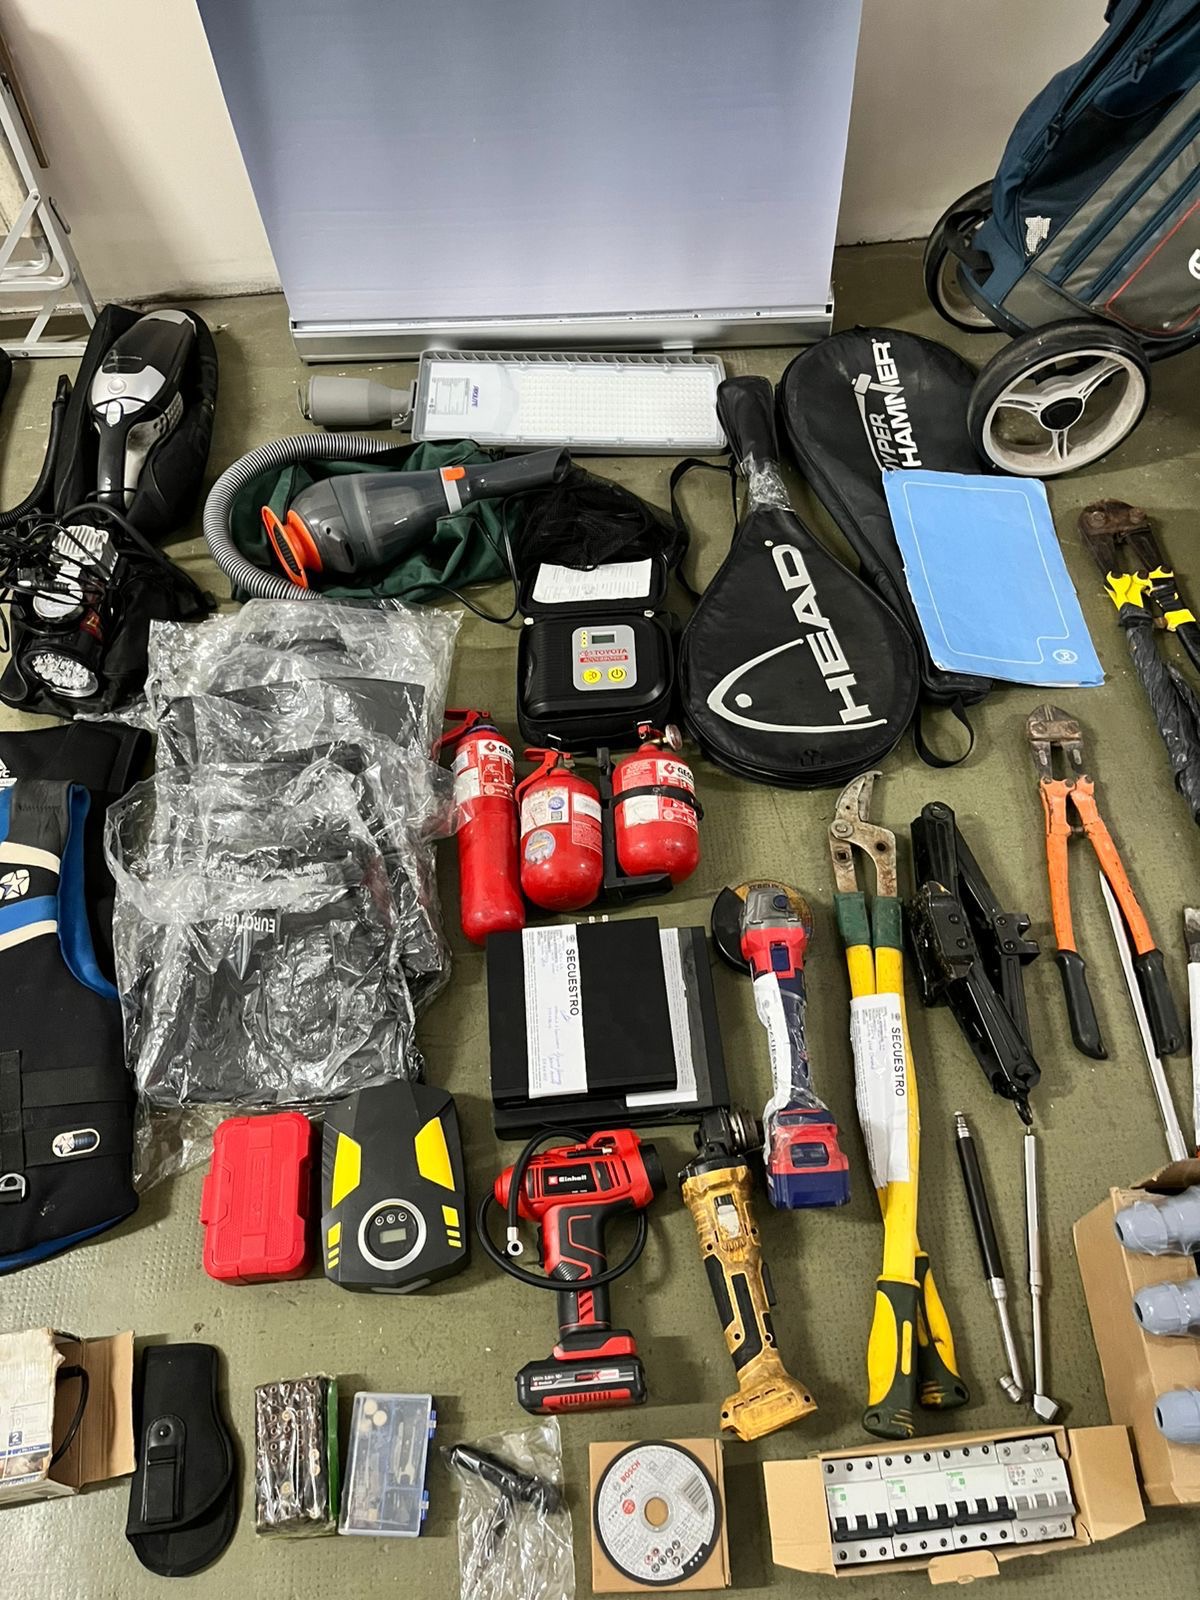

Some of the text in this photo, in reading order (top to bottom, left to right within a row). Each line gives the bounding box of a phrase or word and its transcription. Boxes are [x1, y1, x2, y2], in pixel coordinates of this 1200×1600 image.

[872, 341, 922, 467] HAMMER
[594, 648, 628, 656] TOYOTA
[772, 544, 872, 725] HEAD
[565, 948, 580, 1017] SECUESTRO
[891, 1026, 906, 1097] SECUESTRO
[12, 1431, 19, 1442] 2
[619, 1459, 641, 1483] BOSCH
